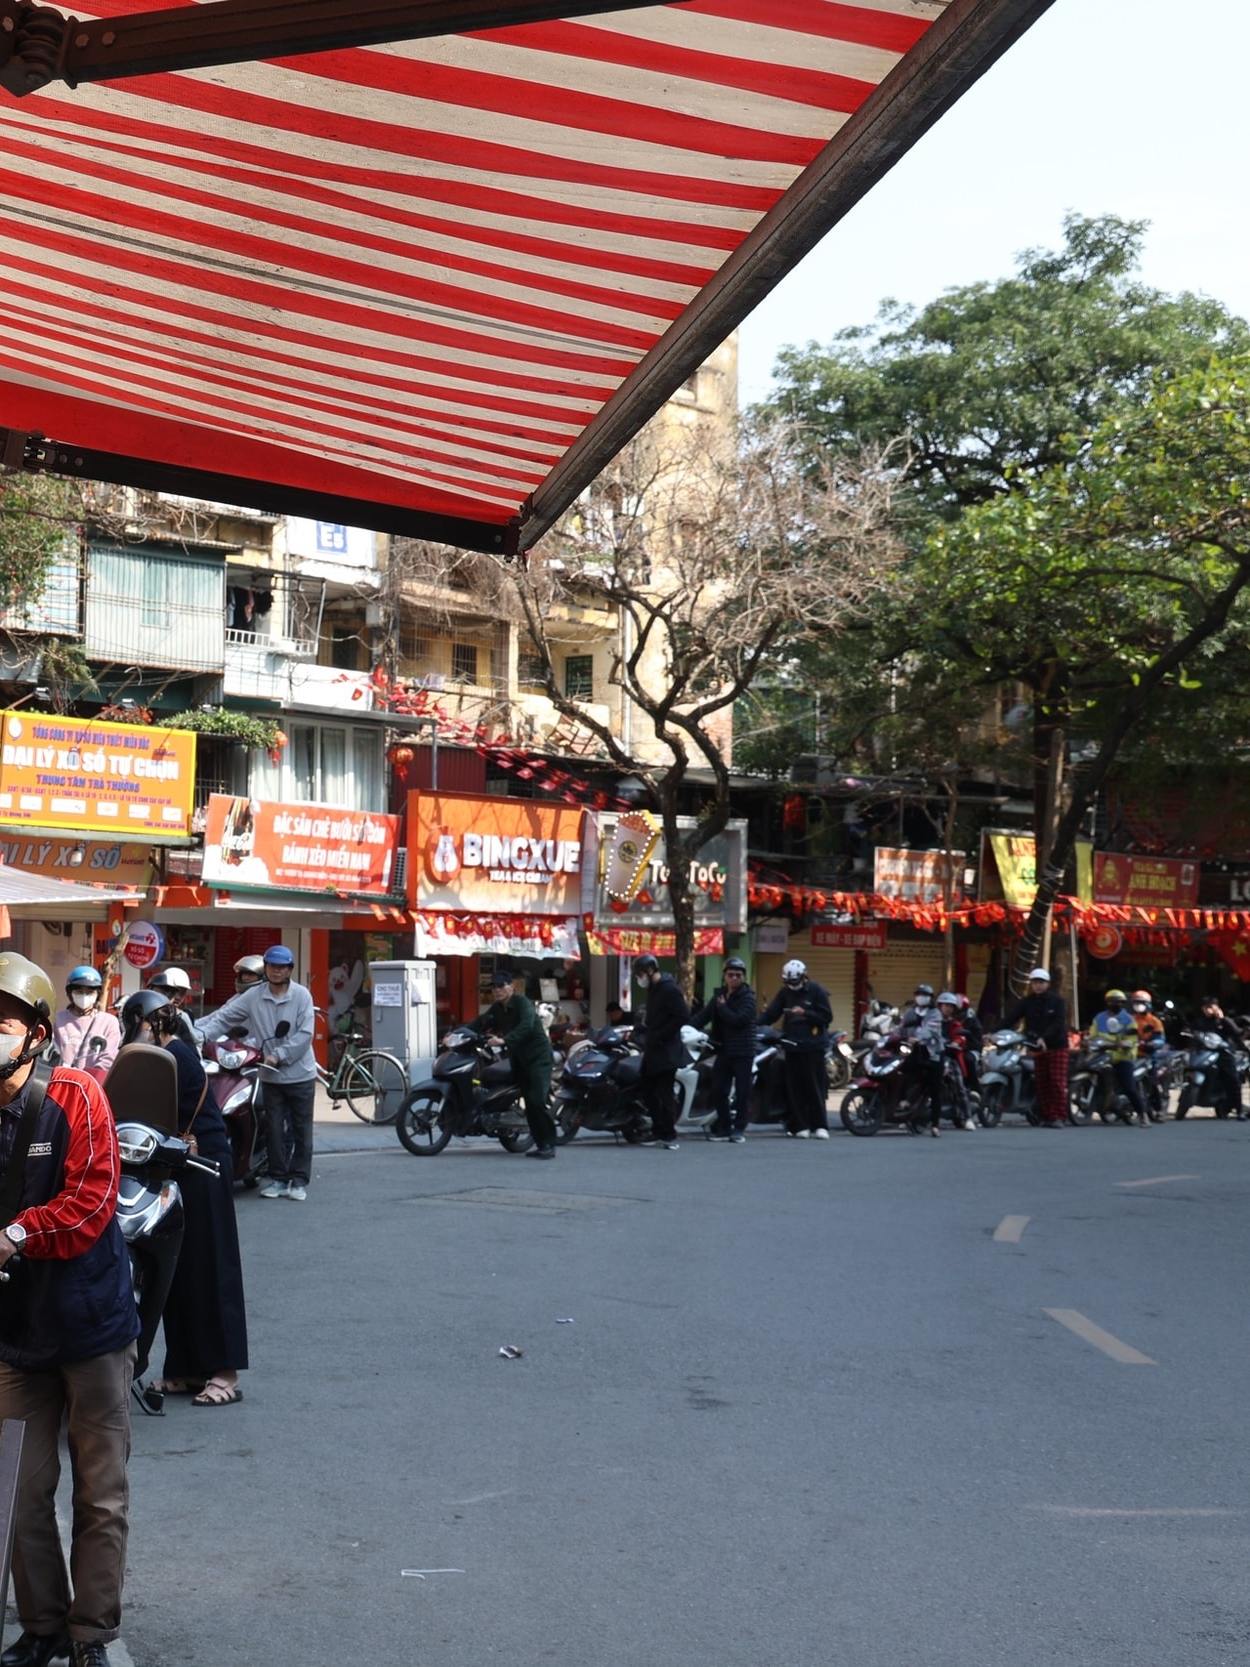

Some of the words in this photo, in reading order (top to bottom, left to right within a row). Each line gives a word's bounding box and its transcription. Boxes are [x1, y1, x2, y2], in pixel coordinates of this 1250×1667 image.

[36, 745, 55, 769] LÝ
[83, 747, 106, 774] SỐ
[109, 754, 134, 779] TỰ
[134, 757, 179, 783] CHỌN
[36, 774, 66, 787] TRUNG
[68, 775, 86, 788] TÂM
[273, 810, 293, 839] ĐẶC
[293, 812, 312, 836] SẢN
[312, 816, 330, 838] CHÈ
[22, 841, 52, 865] LÝ
[90, 841, 126, 870] SỐ
[282, 841, 308, 865] BÁNH
[308, 844, 325, 867] XÈO
[349, 851, 371, 871] NAM
[463, 833, 580, 872] BINGXUE
